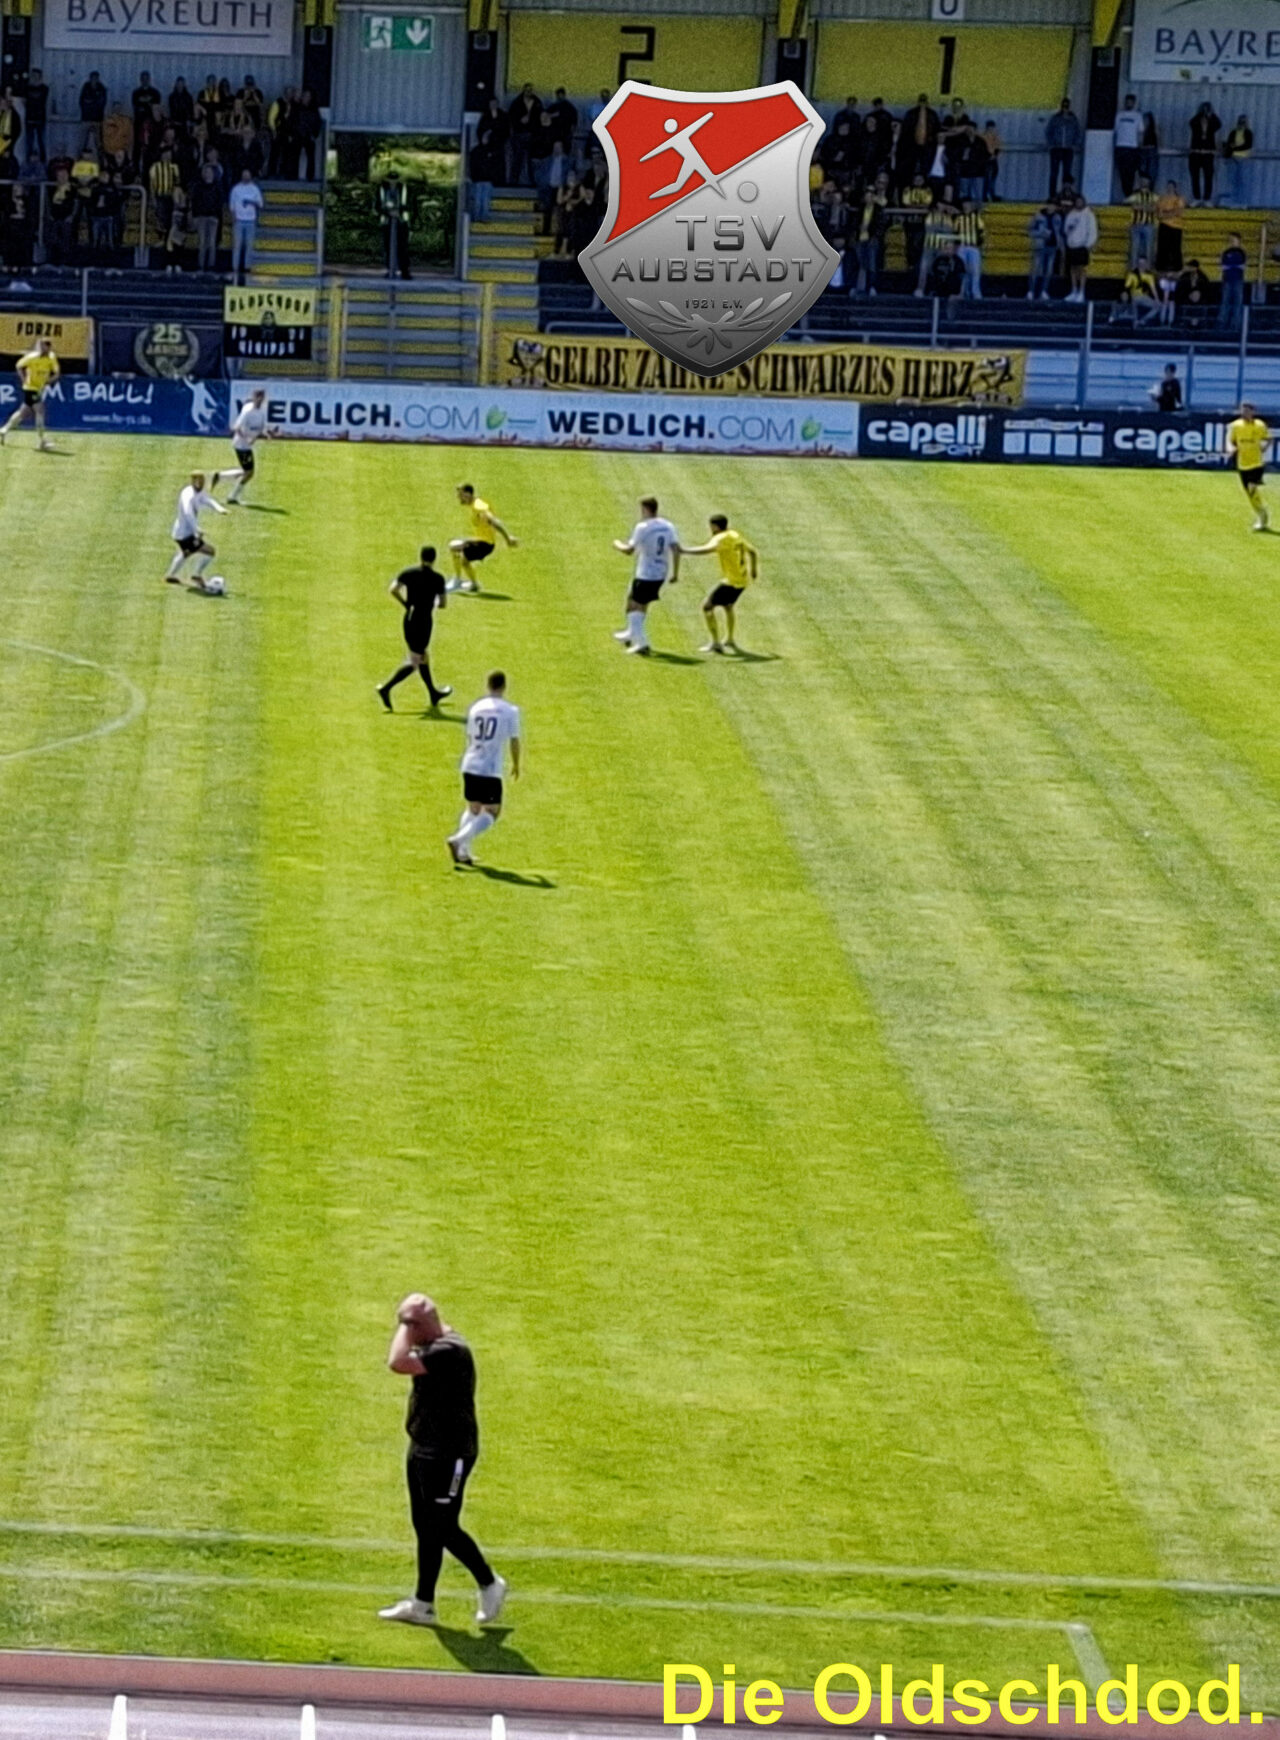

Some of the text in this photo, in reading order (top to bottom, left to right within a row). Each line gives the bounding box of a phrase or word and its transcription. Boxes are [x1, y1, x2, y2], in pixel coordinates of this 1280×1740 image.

[619, 26, 656, 84] 2
[938, 36, 957, 95] 1
[152, 323, 183, 343] 25
[544, 344, 629, 388] GELBE
[901, 357, 975, 399] HERZ
[74, 381, 154, 404] BALL!
[235, 399, 479, 430] EDLICH.COM
[474, 716, 498, 741] 30
